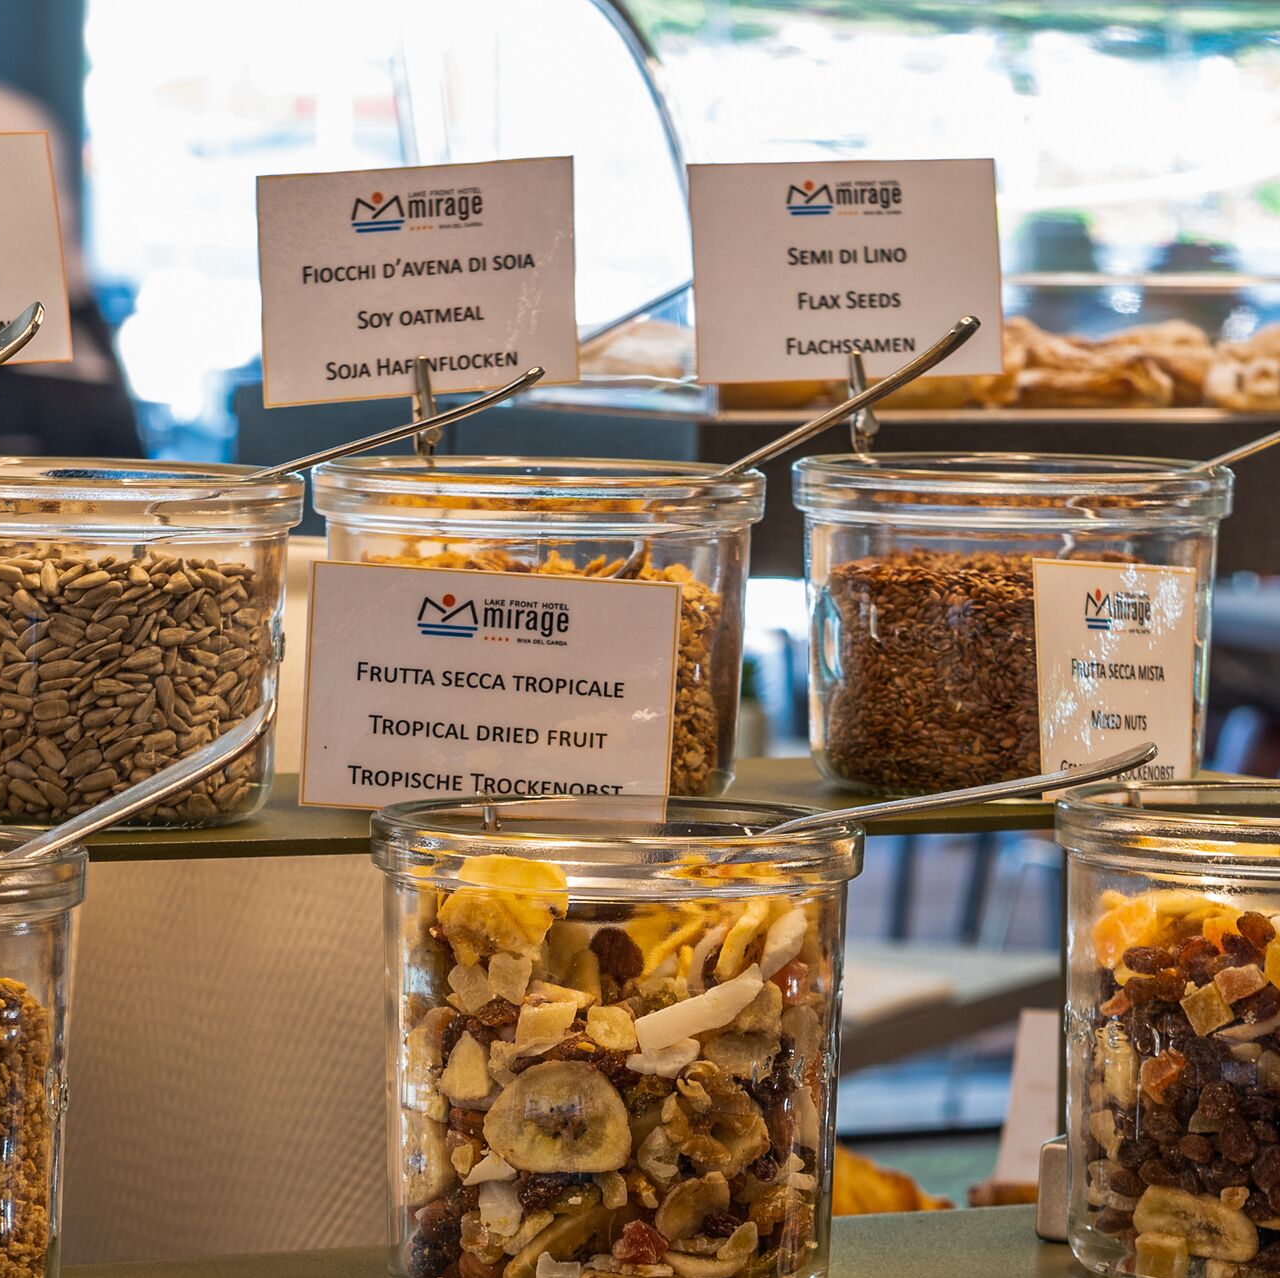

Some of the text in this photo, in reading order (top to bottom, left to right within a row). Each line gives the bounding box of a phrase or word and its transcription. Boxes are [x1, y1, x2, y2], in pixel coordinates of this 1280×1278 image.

[408, 195, 483, 221] mirage
[836, 187, 902, 209] mirage
[377, 351, 518, 377] HAFNFLOCKEN
[509, 600, 539, 609] FRONT
[542, 602, 569, 611] HOTEL
[483, 607, 569, 638] mirage
